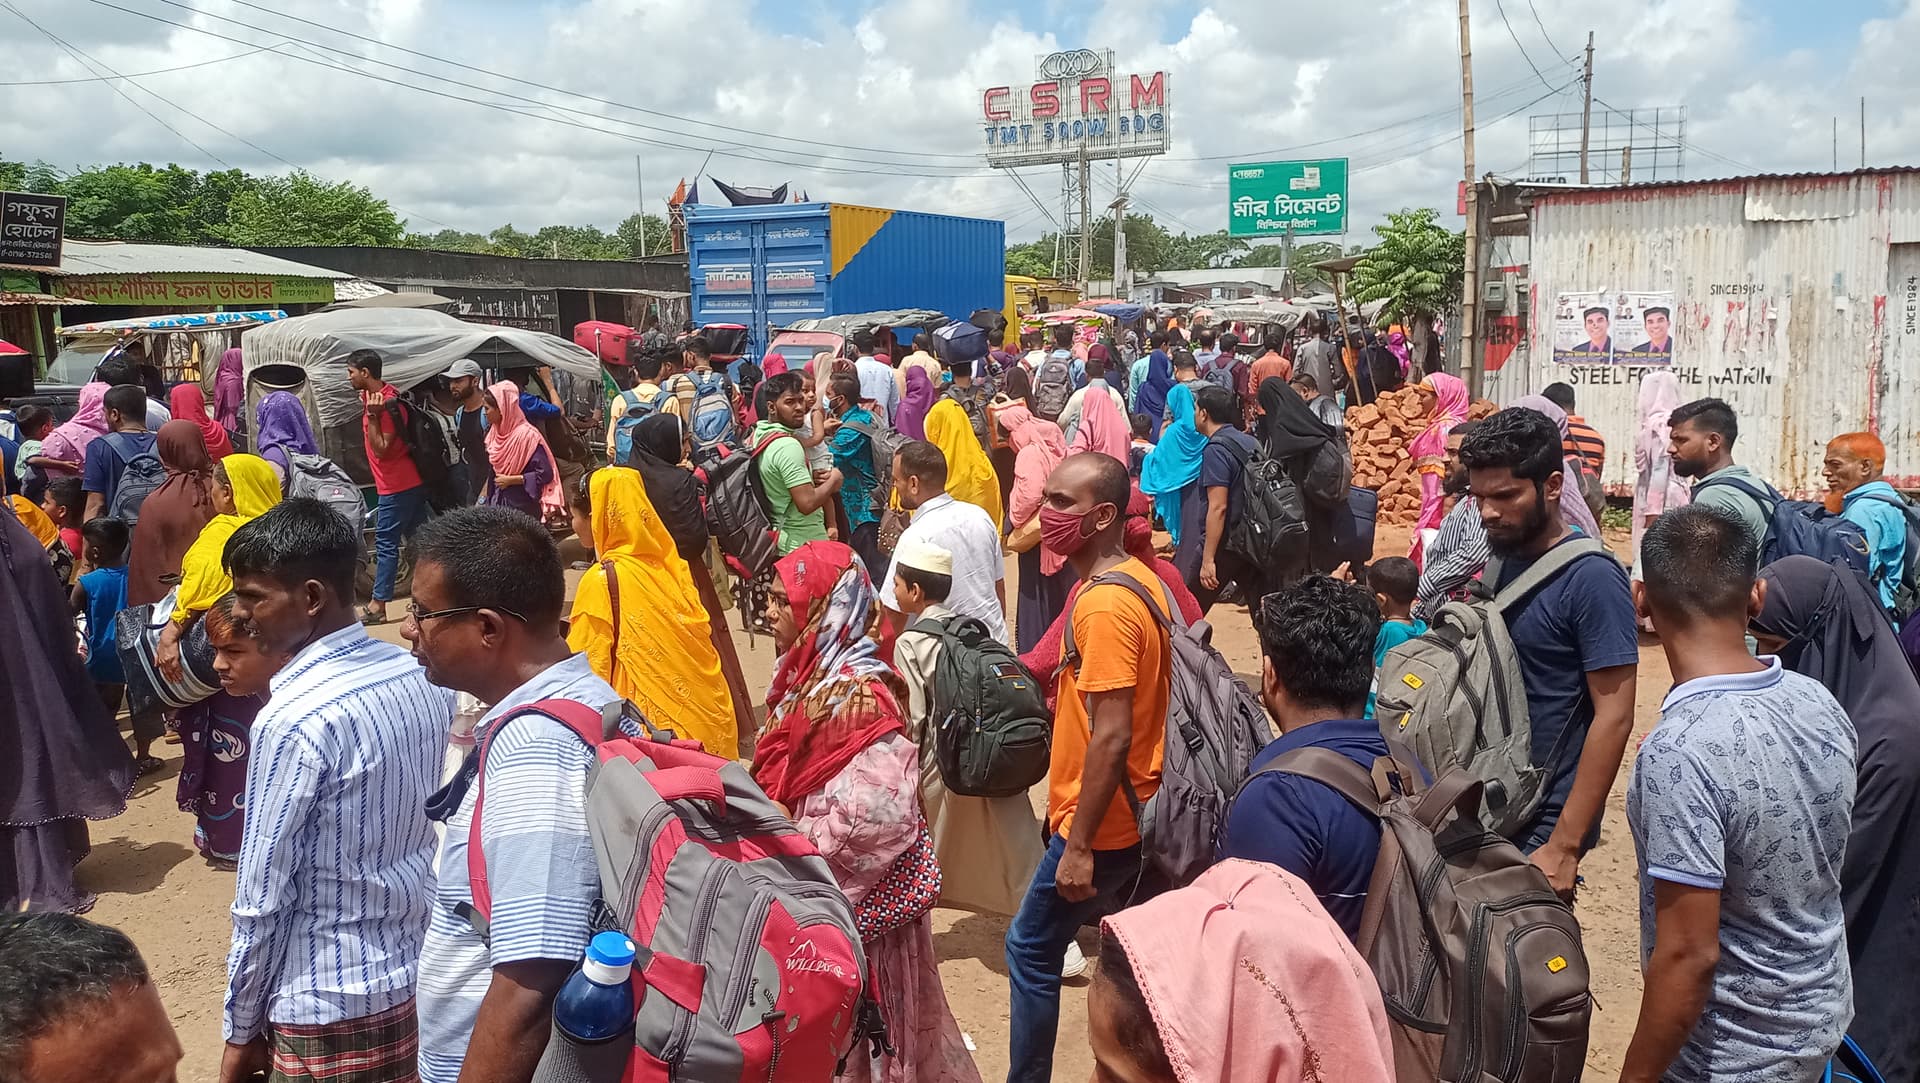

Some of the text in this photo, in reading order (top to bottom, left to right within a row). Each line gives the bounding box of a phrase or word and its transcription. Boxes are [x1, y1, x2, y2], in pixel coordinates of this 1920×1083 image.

[984, 71, 1165, 121] CSRM
[984, 124, 1033, 145] TMT
[7, 202, 59, 221] গফুর
[1232, 193, 1342, 218] মীর সিমেন্ট
[5, 222, 59, 239] হোটেল
[172, 279, 212, 300] ফল
[216, 278, 273, 300] ভান্ডার
[1709, 284, 1738, 296] SINCE
[1905, 275, 1918, 335] SINCE 1984
[1569, 367, 1622, 385] STEEL
